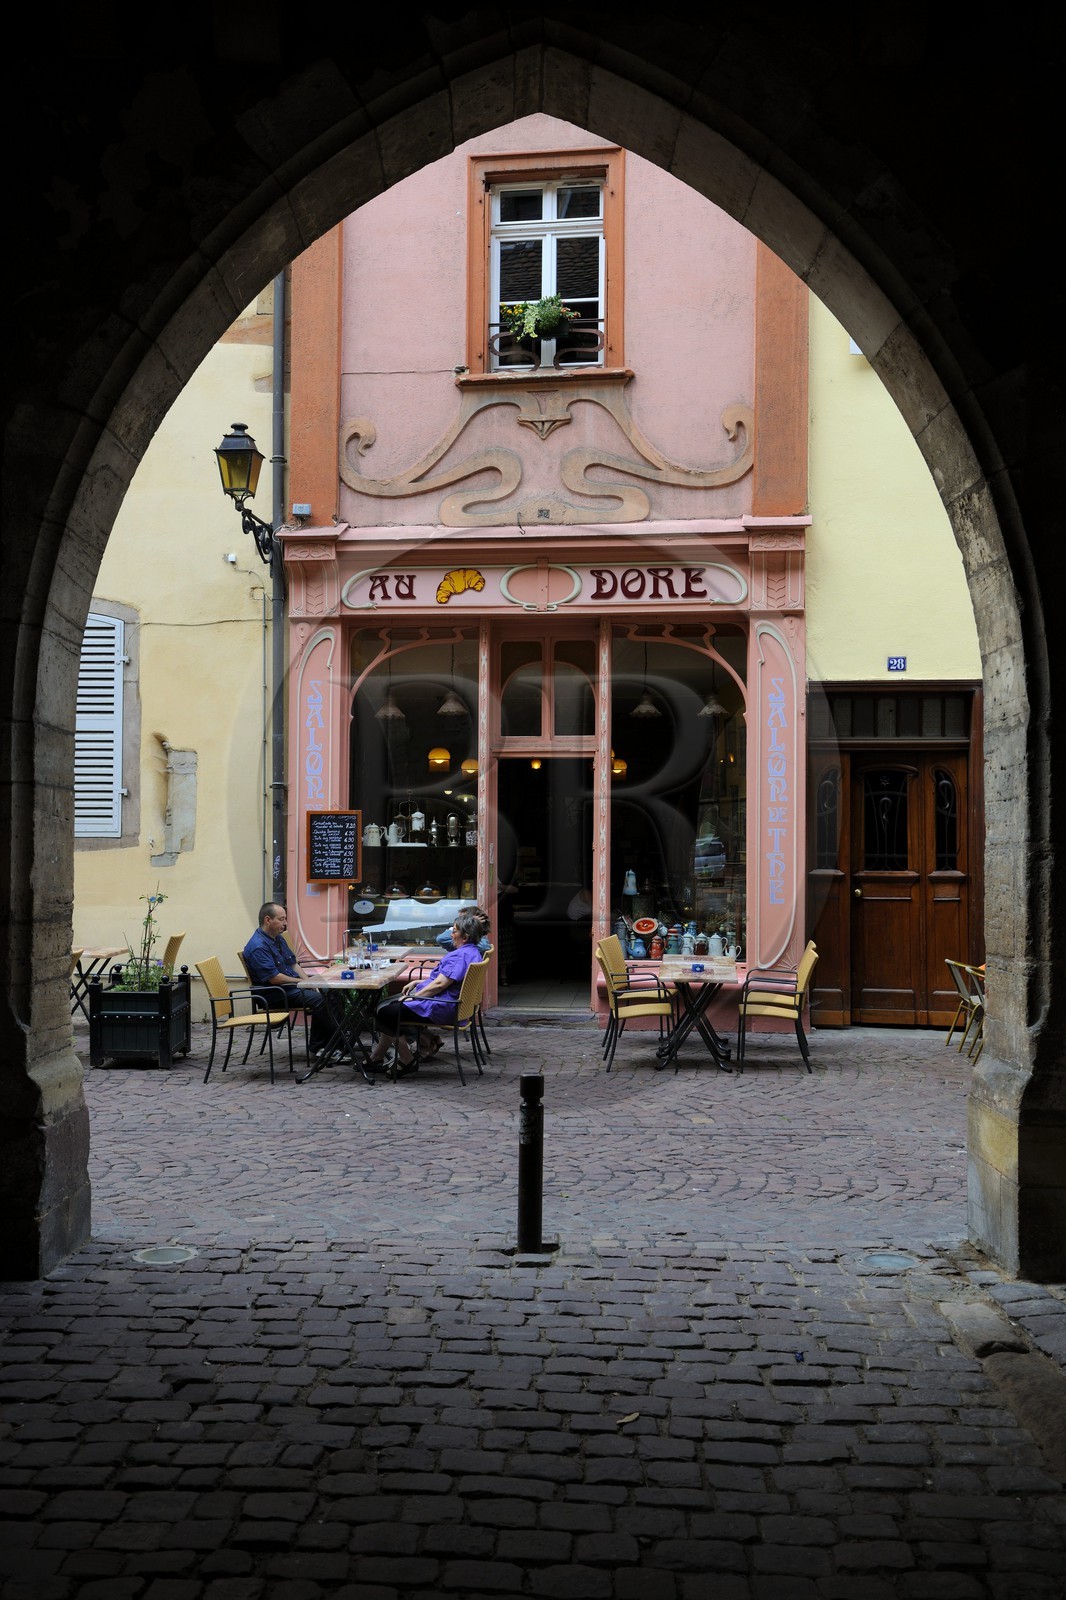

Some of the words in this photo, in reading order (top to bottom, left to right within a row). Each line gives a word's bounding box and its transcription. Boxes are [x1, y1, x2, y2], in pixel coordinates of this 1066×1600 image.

[368, 573, 416, 600] AU
[590, 568, 707, 600] DORE
[889, 658, 905, 670] 28
[305, 680, 325, 799] SALON
[767, 677, 788, 802] SALON
[767, 807, 788, 823] DE
